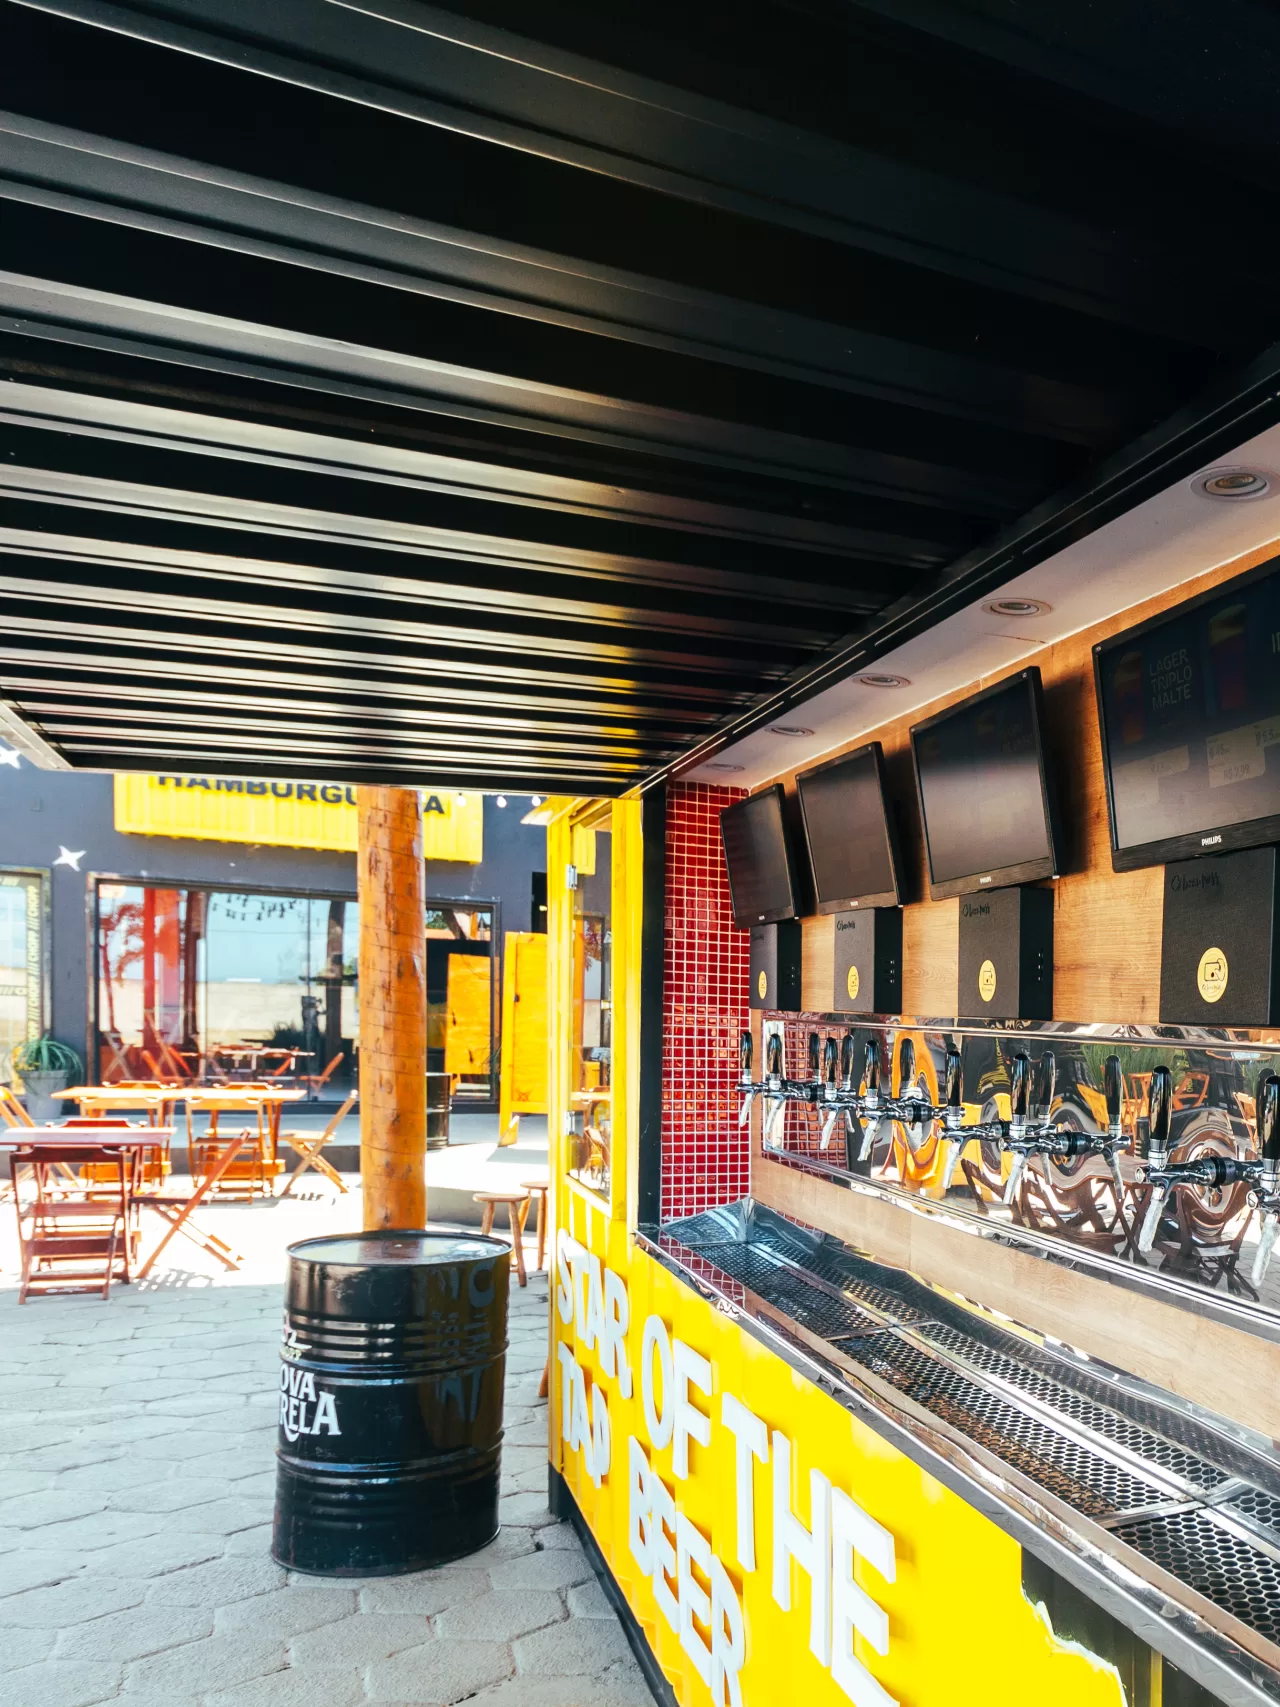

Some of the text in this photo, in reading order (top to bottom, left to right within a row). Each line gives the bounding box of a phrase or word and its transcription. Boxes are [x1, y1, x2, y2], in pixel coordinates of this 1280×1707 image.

[1149, 648, 1189, 677] LAGER
[1150, 665, 1192, 695] TRIPLO
[1152, 683, 1193, 711] MALTE
[158, 775, 445, 815] HAMBURGUA
[1201, 834, 1222, 847] PHILIPS
[27, 885, 40, 917] CHOPP
[27, 930, 40, 962] CHOPP
[27, 975, 40, 1007] CHOPP
[557, 1228, 898, 1706] STAR OF THE
[557, 1340, 746, 1706] TAP BEER
